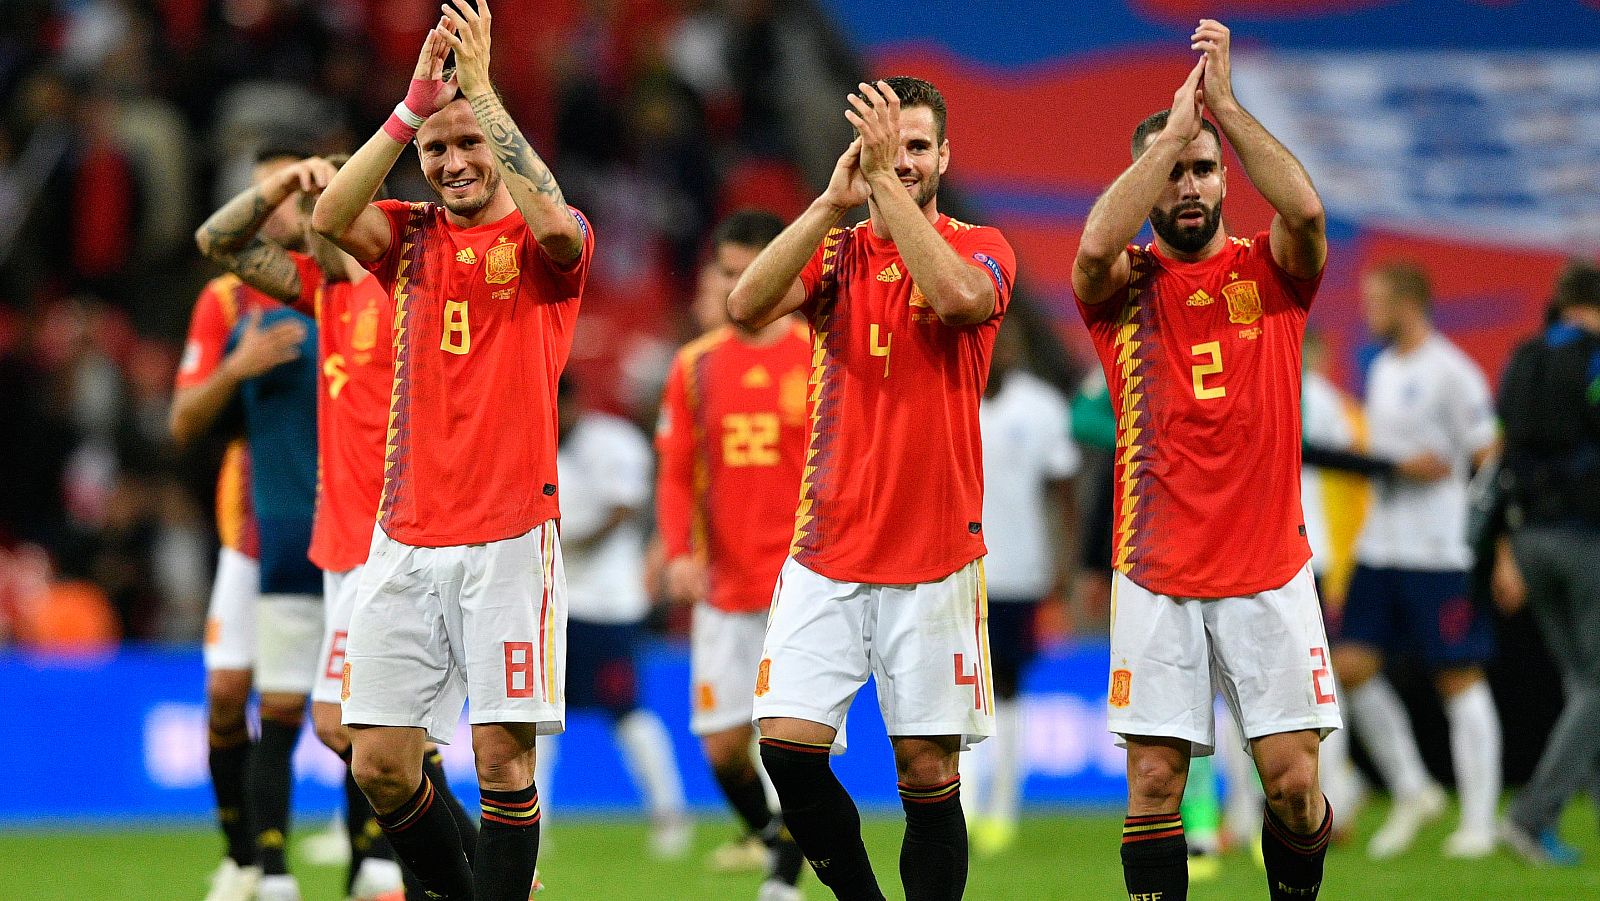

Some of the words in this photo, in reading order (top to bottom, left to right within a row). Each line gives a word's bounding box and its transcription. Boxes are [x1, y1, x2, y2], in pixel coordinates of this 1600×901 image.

[440, 299, 471, 356] 8
[869, 323, 893, 379] 4
[1191, 341, 1227, 400] 2
[721, 412, 782, 468] 22
[503, 641, 534, 699] 8
[952, 653, 982, 710] 4
[1309, 646, 1336, 705] 2
